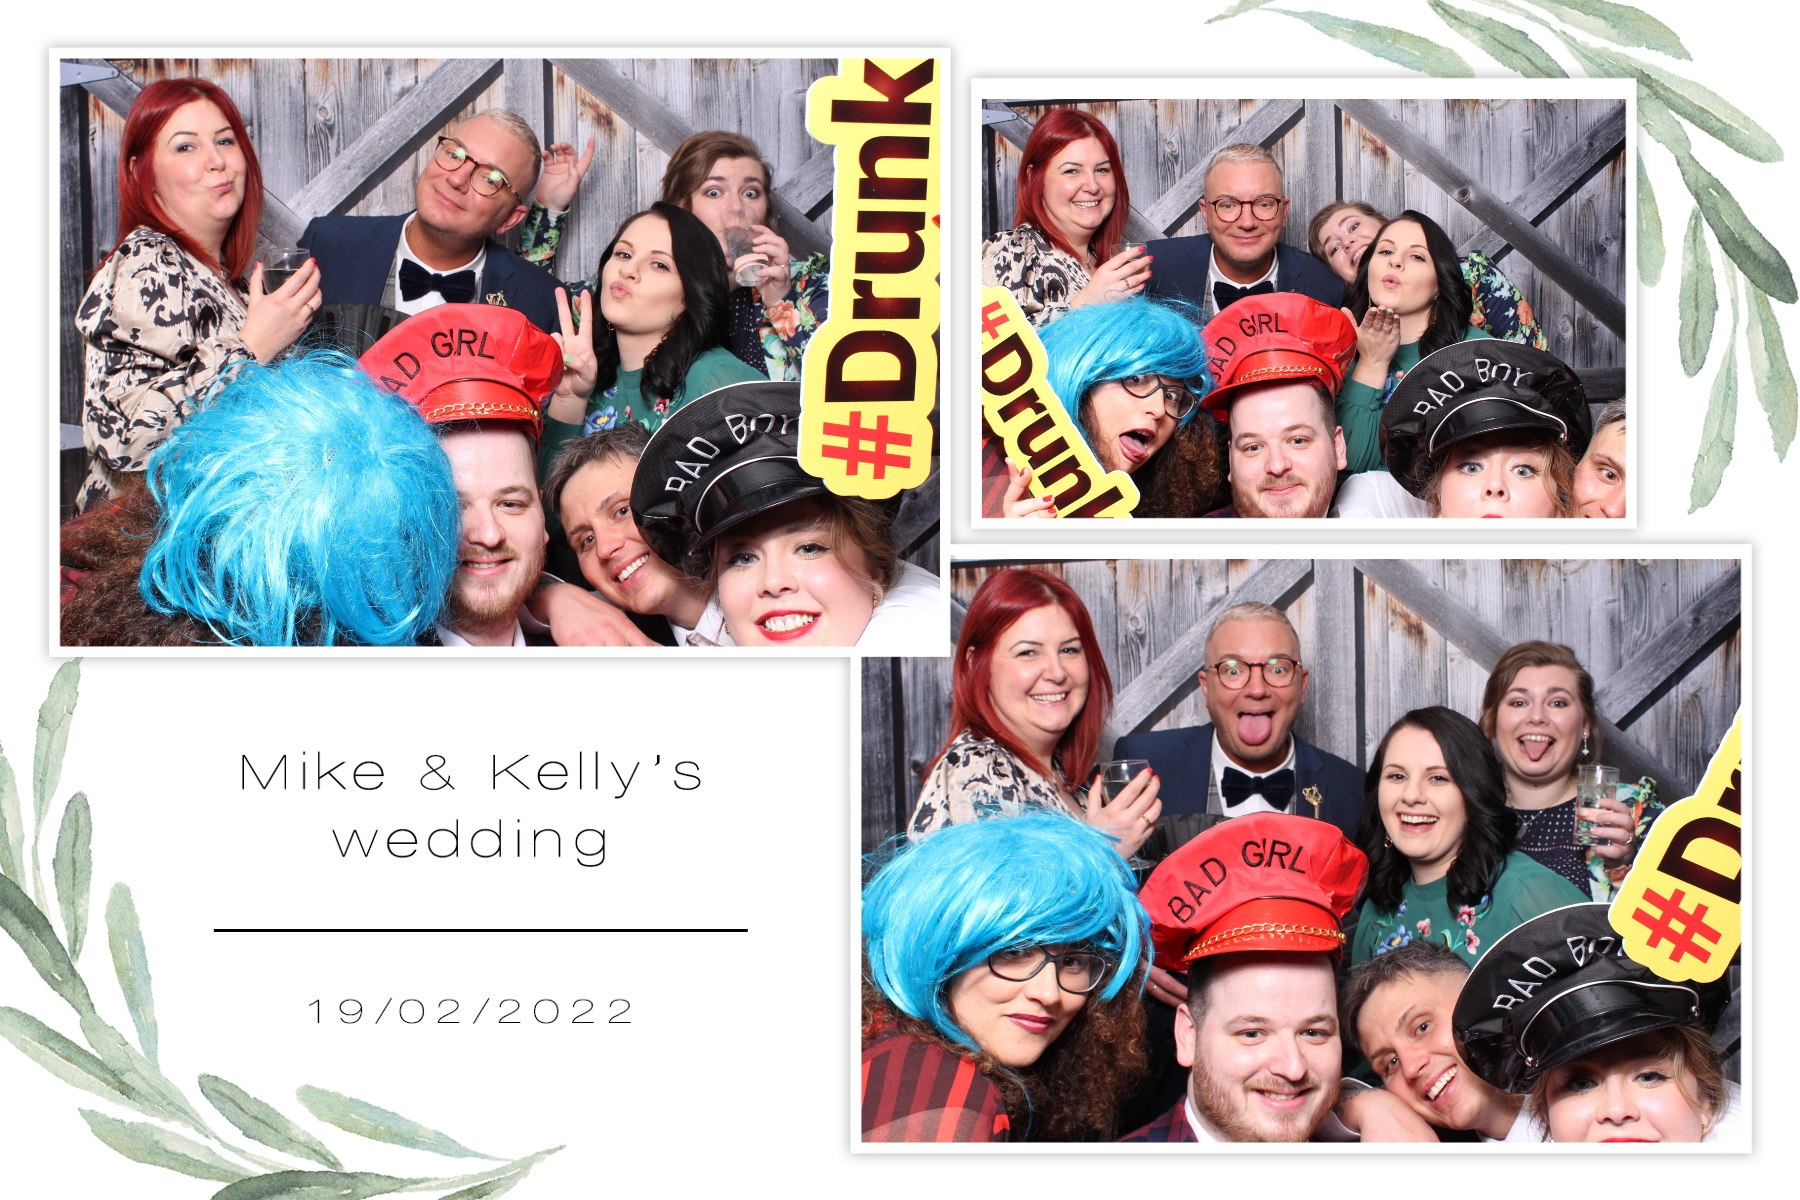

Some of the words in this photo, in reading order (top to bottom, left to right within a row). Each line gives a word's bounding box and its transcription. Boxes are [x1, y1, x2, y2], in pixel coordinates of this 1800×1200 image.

[821, 58, 934, 480] #Drunk
[1238, 313, 1288, 337] GIRL
[380, 352, 421, 393] AD
[431, 328, 495, 359] GIRL
[1413, 371, 1465, 415] BAD
[1168, 858, 1227, 923] BAD
[1241, 838, 1306, 874] GIRL
